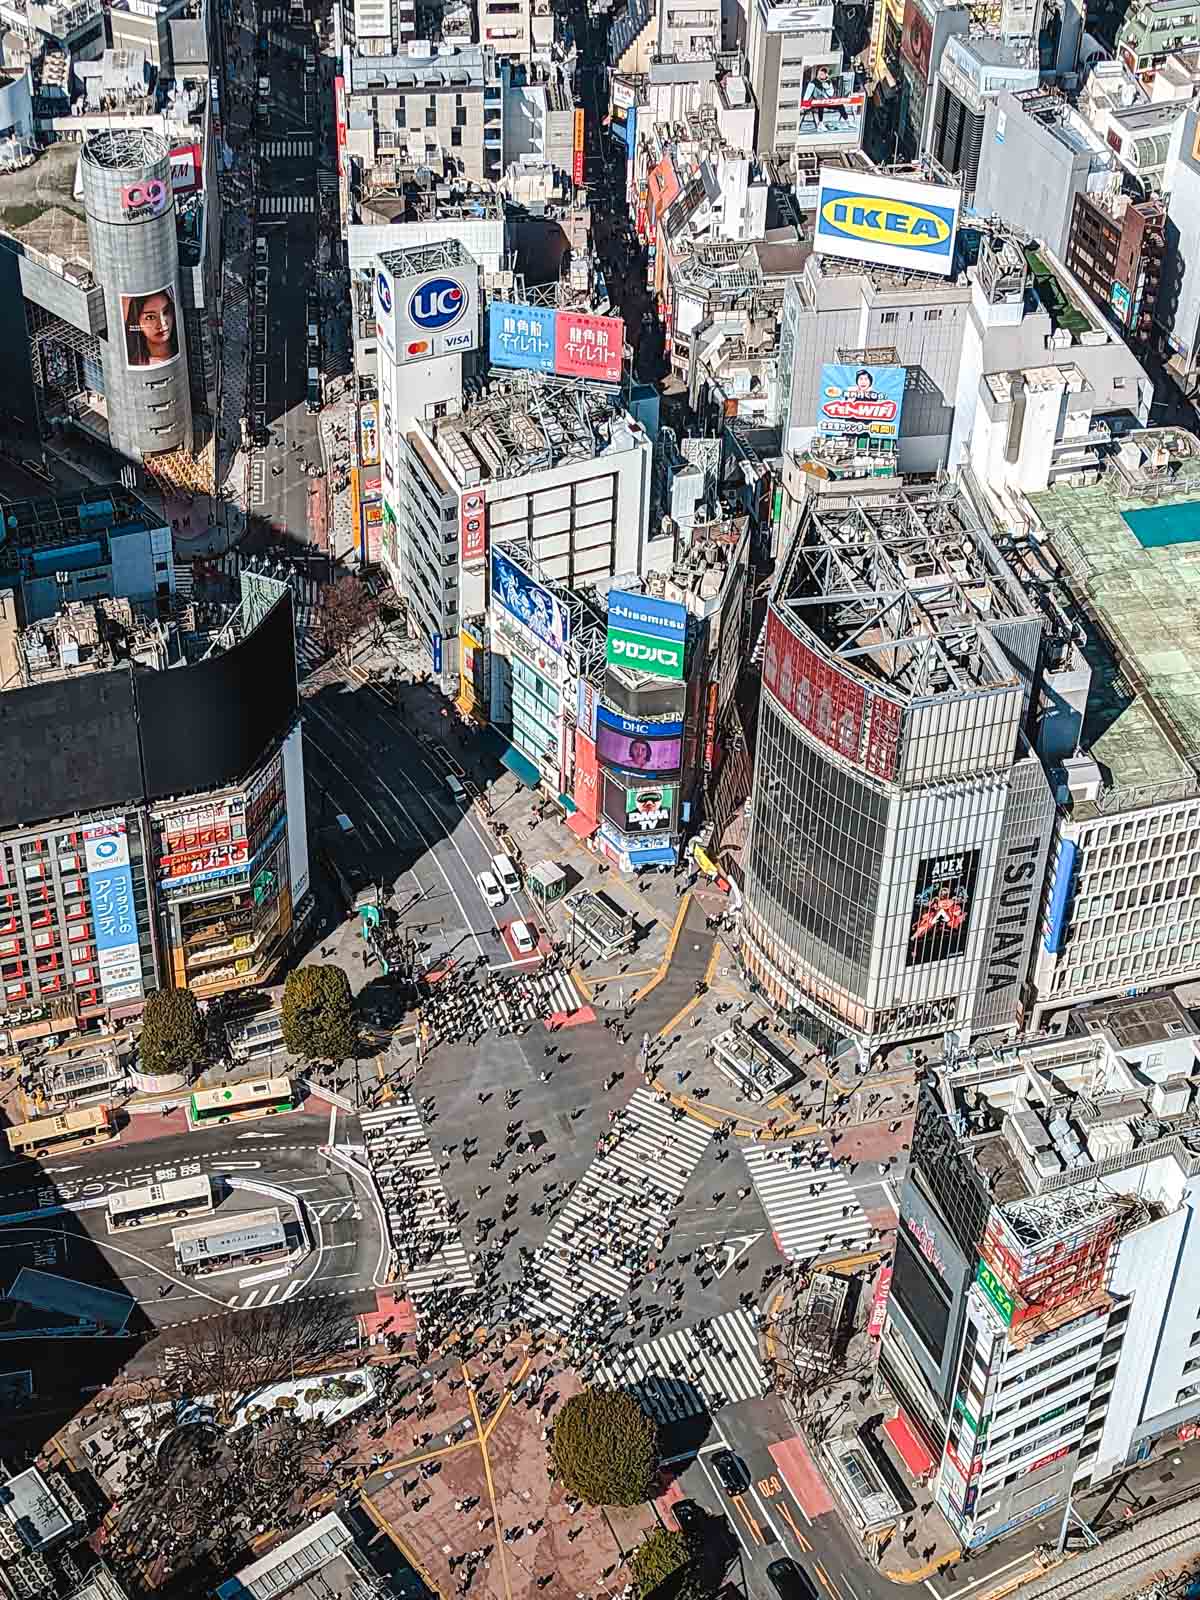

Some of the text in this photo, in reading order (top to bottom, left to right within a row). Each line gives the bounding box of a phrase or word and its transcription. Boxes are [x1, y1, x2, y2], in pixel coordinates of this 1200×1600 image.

[833, 203, 940, 240] IKEA
[414, 288, 462, 319] UC
[445, 335, 470, 348] VISA
[611, 639, 679, 668] サロンパス
[622, 721, 649, 734] DHC
[628, 809, 669, 823] DMM
[638, 819, 658, 830] TV
[932, 857, 964, 876] APEX
[986, 838, 1041, 994] TSUTAYA
